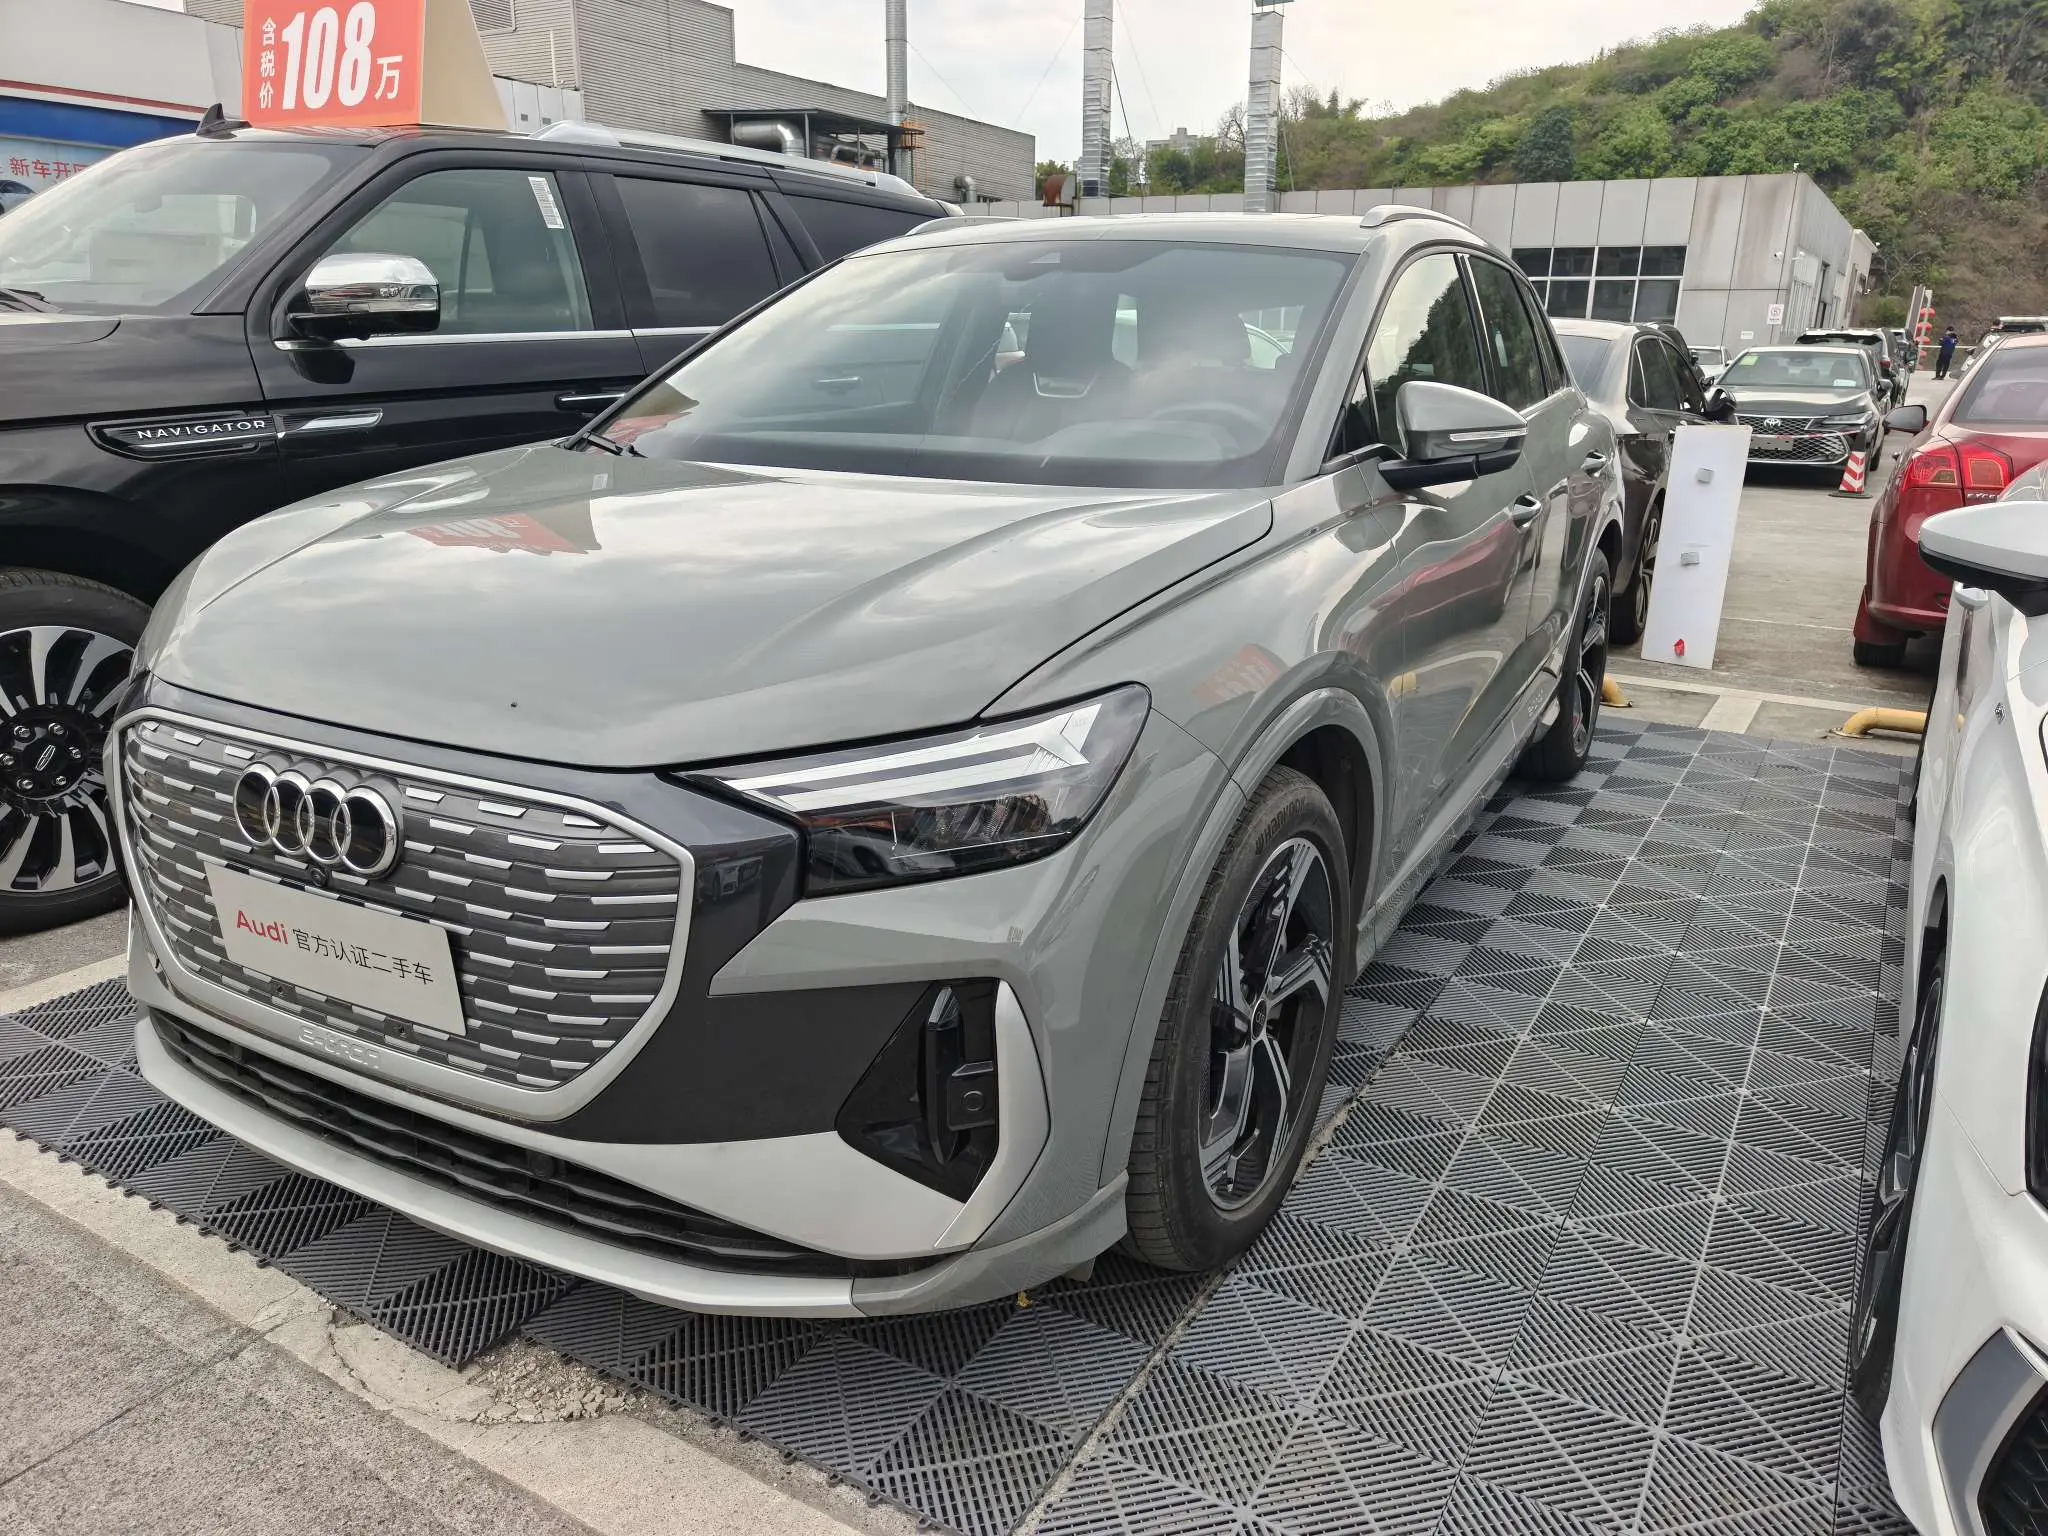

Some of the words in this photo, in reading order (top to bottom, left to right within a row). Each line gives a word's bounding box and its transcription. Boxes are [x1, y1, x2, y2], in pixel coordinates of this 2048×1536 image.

[259, 16, 277, 110] 含税价
[137, 420, 266, 439] NAVIGATOR
[236, 910, 289, 945] Audi
[292, 928, 434, 985] 官方认证二手车
